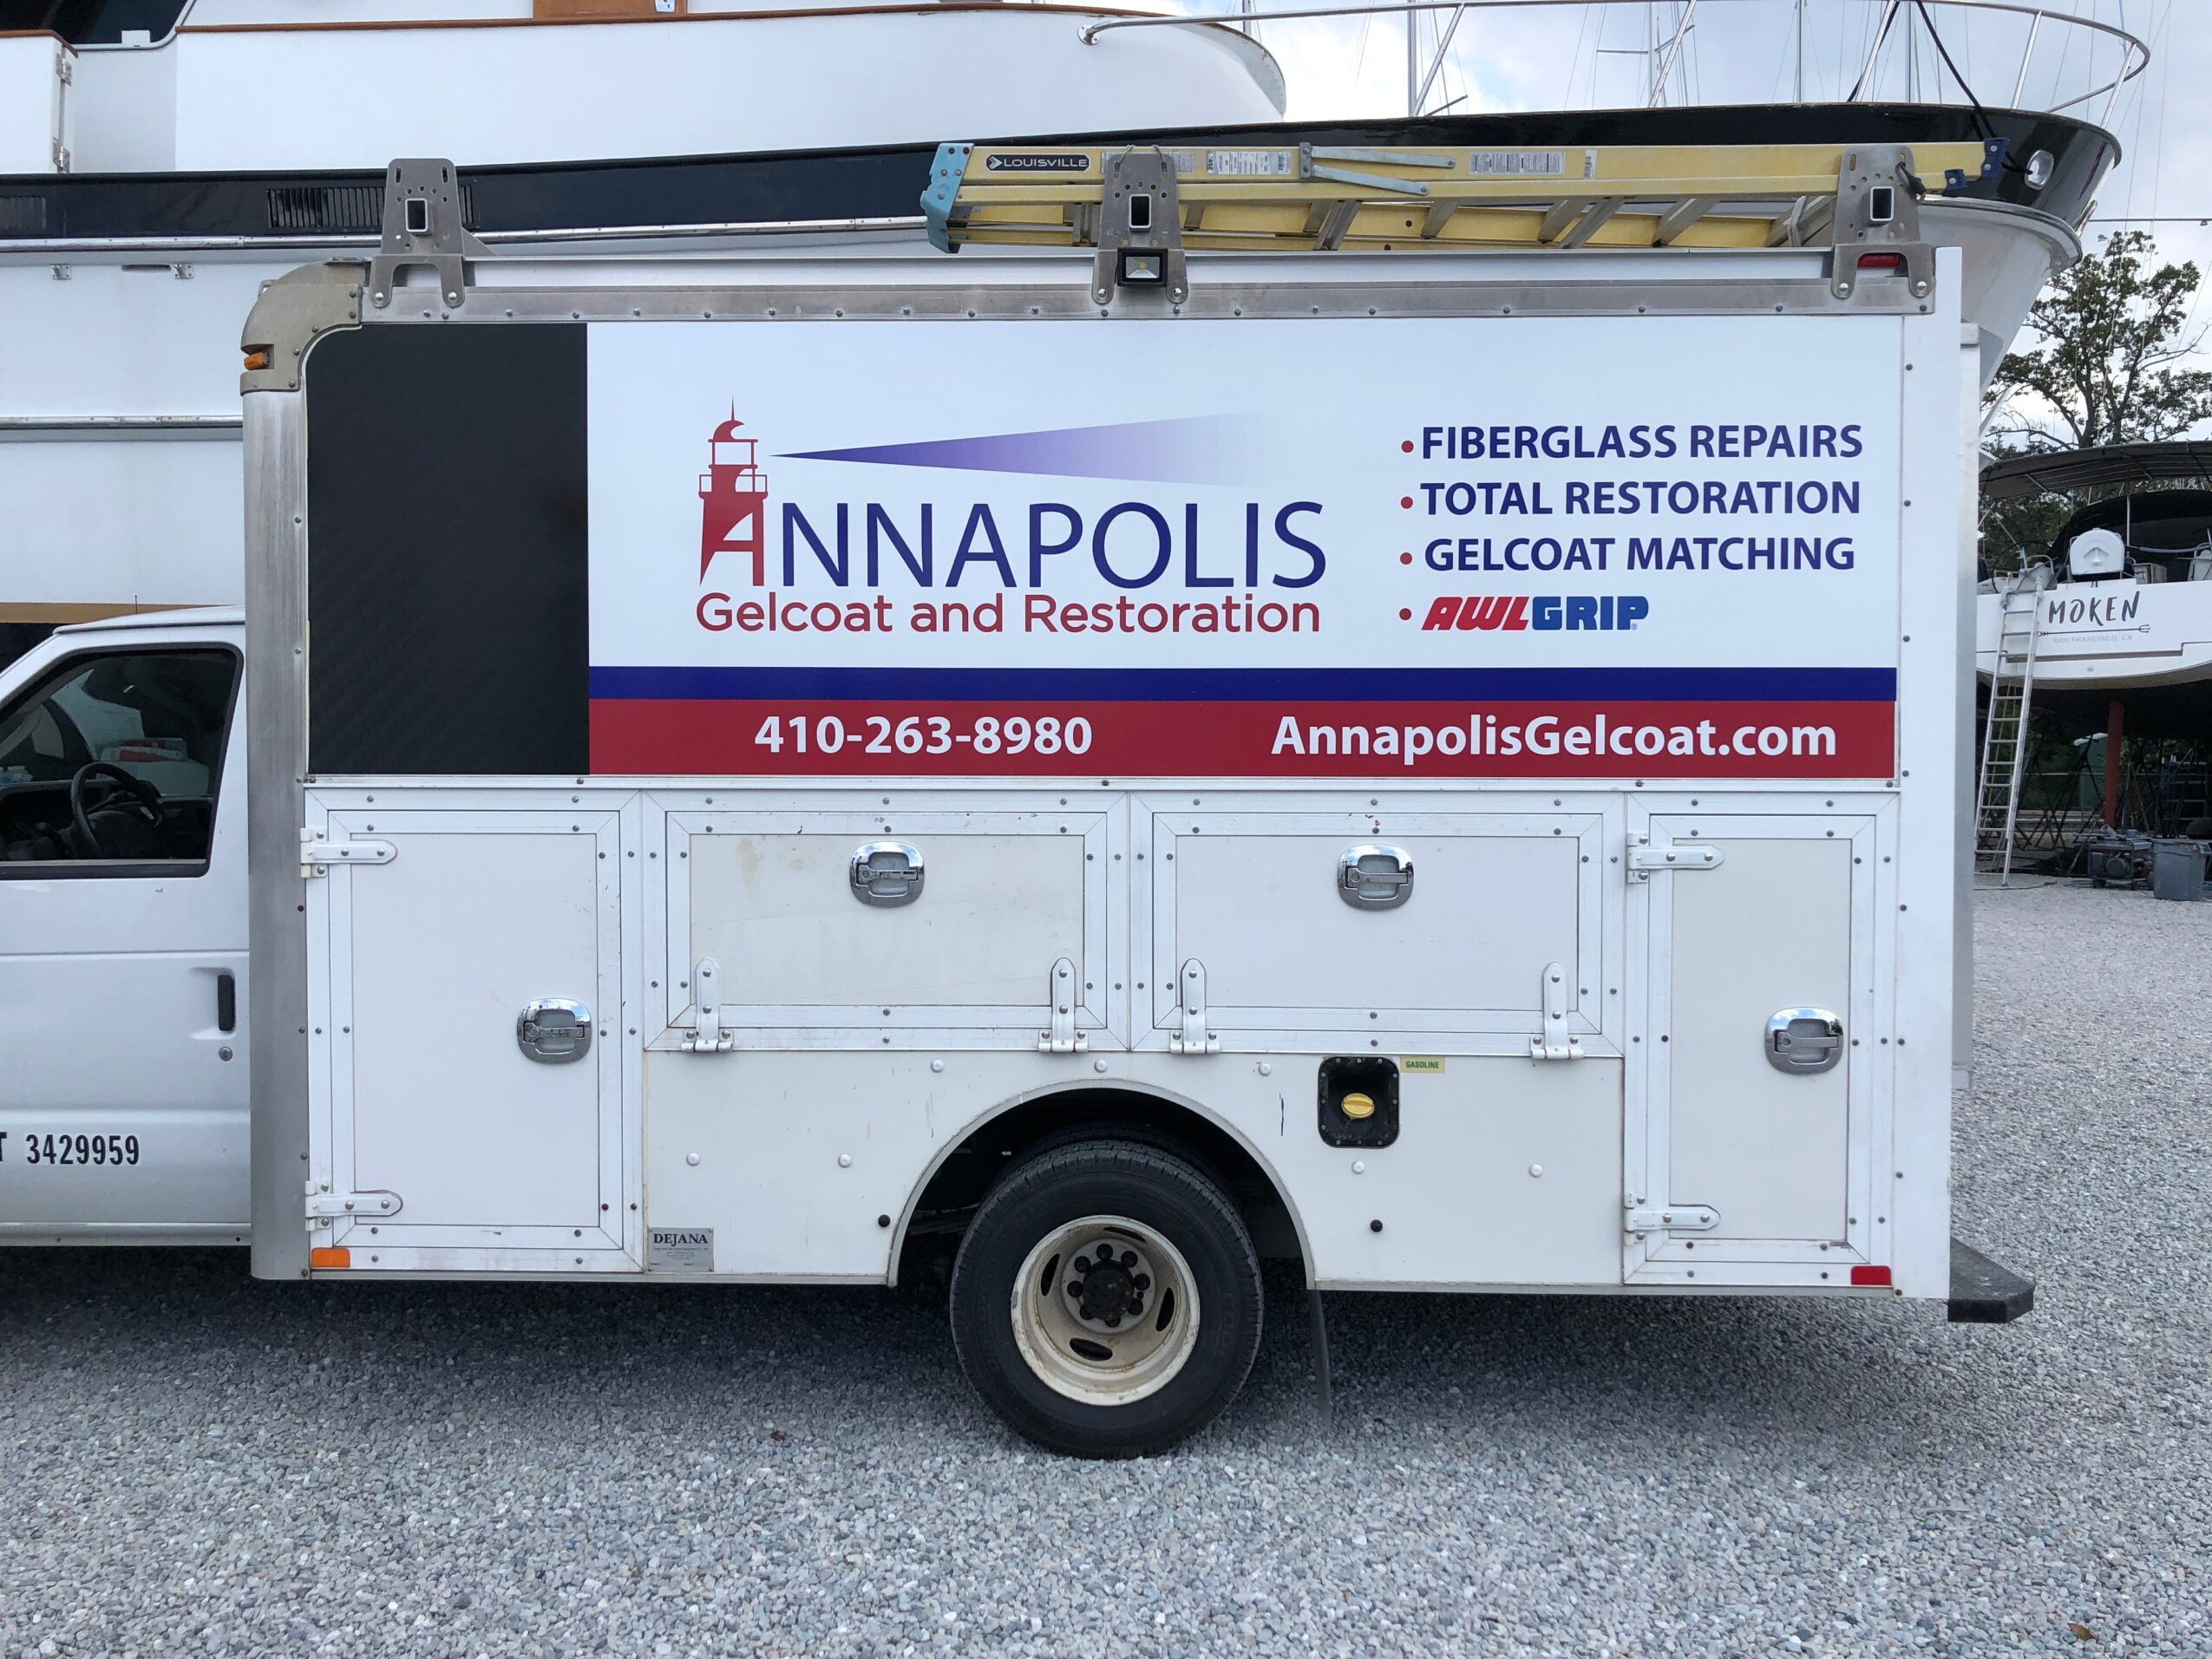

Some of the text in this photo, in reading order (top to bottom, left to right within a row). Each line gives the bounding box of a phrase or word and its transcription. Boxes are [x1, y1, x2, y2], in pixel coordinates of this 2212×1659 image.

[1004, 158, 1088, 167] LOUISVILLE
[1423, 424, 1863, 460] FIBERGLASS REPAIRS
[1420, 480, 1860, 515] TOTAL RESTORATION
[699, 488, 1326, 590] ANNAPOLIS
[1424, 537, 1855, 572] GELCOAT MATCHING
[696, 591, 1320, 633] Gelcoat and Restoration
[2048, 591, 2141, 626] MOKEN
[754, 715, 1092, 754] 410-263-8980
[1271, 714, 1836, 766] AnnapolisGelcoat.com
[25, 1133, 140, 1166] 3429959
[653, 1233, 709, 1247] DEJANA
